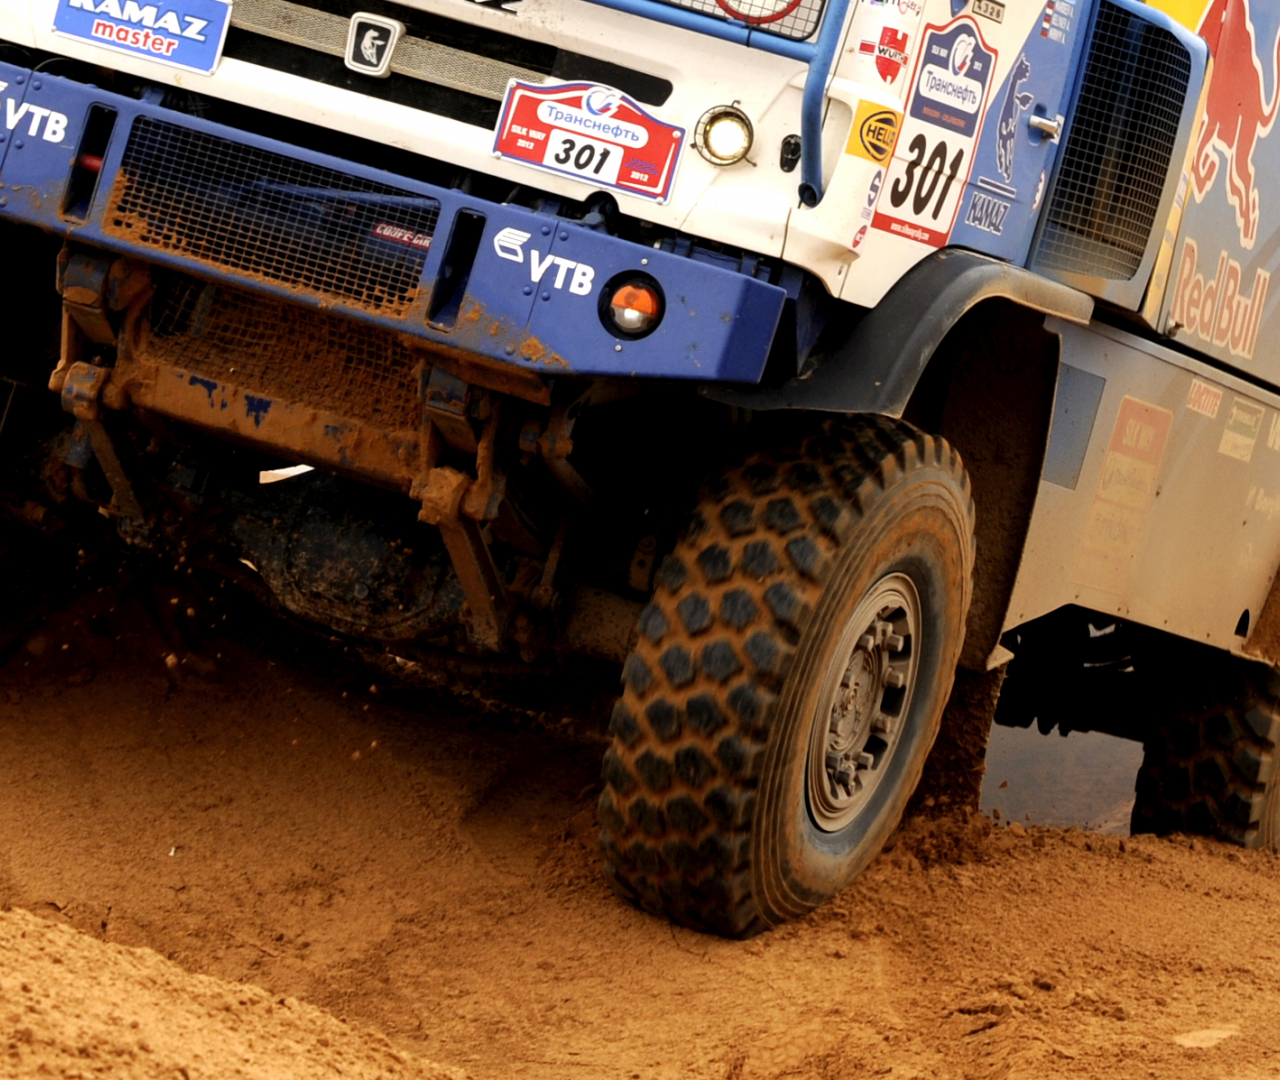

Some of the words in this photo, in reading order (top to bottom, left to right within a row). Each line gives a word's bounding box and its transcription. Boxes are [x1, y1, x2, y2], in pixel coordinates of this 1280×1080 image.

[92, 19, 178, 56] master
[925, 70, 977, 105] Транснефть
[6, 98, 69, 144] VTB
[511, 124, 528, 137] SILK
[529, 128, 546, 141] WAY
[547, 105, 640, 142] Транснефть
[554, 139, 611, 174] 301
[890, 133, 964, 221] 301
[964, 191, 1011, 236] KAMAZ
[530, 249, 595, 296] VTB
[1171, 236, 1228, 347] Red
[1214, 255, 1270, 360] Bull
